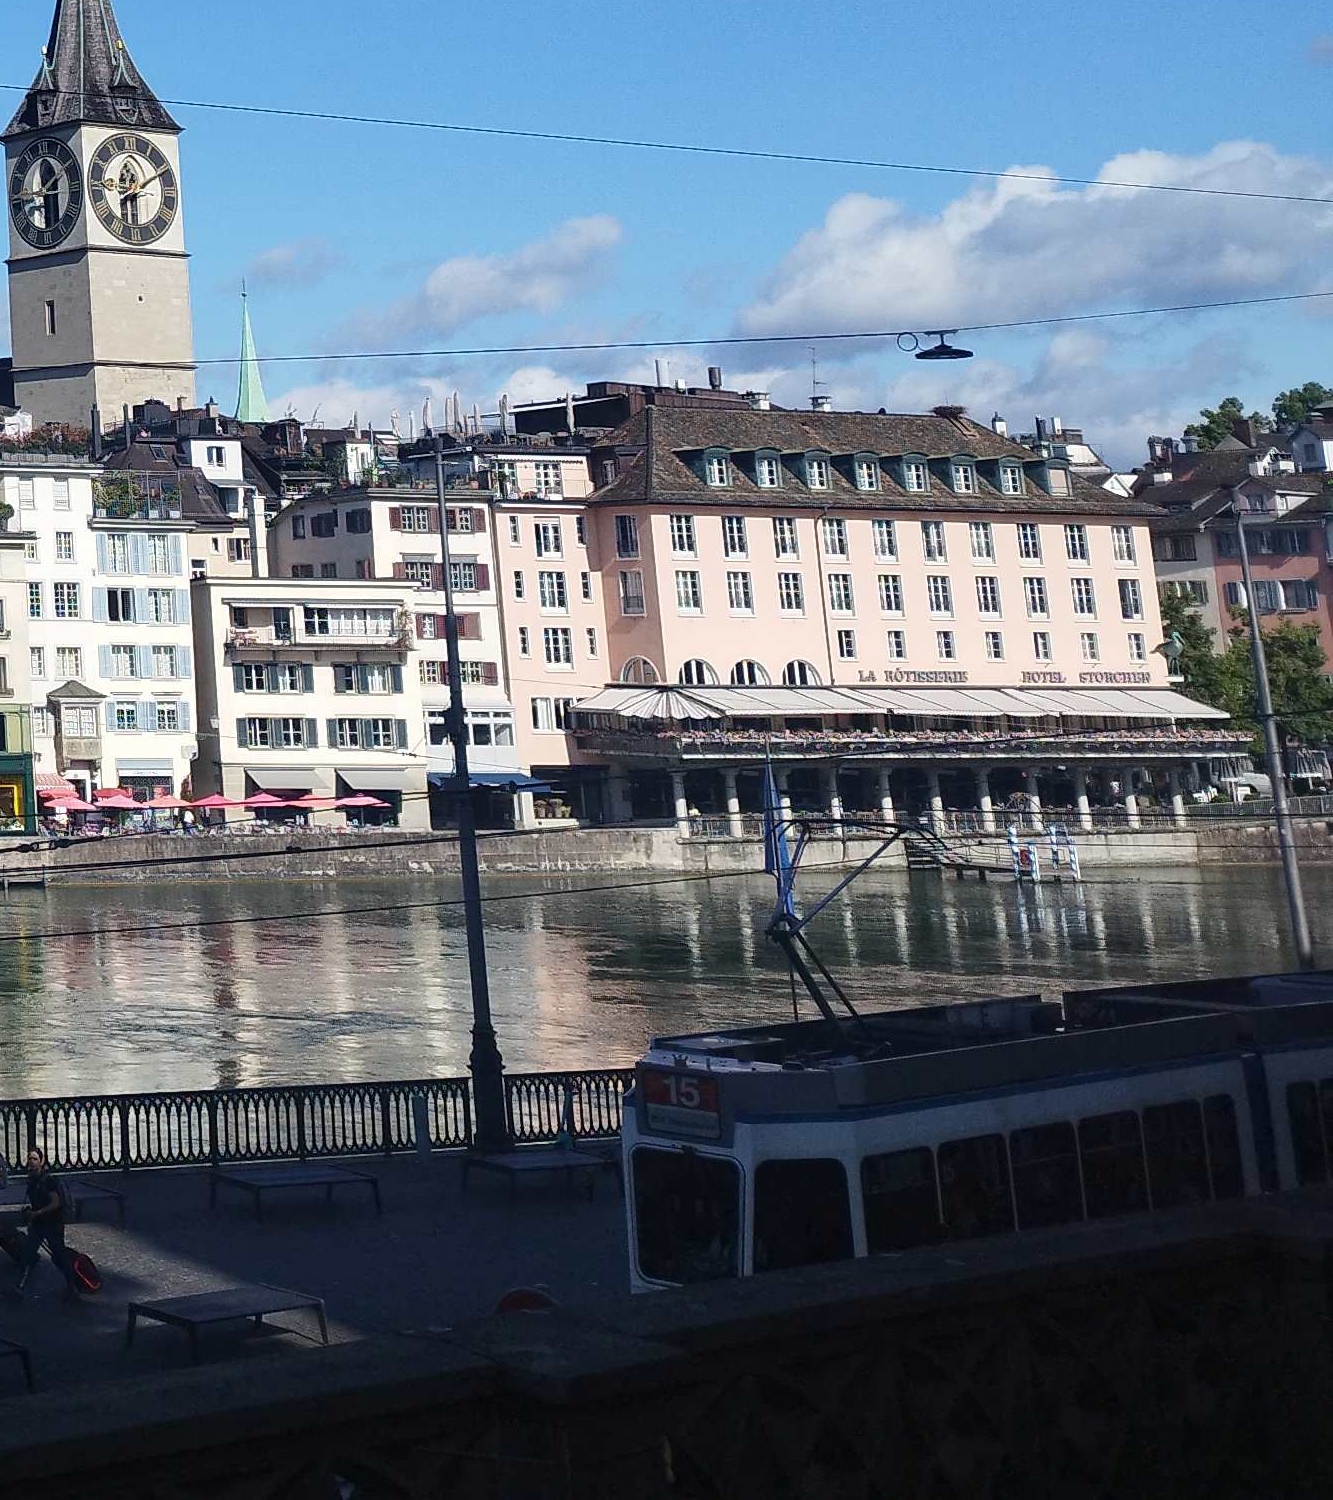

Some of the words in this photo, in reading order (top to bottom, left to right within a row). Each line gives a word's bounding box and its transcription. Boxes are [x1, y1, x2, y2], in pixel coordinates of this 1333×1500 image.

[858, 669, 877, 682] LA
[1021, 670, 1066, 684] HOTEL
[1079, 671, 1152, 685] STORCHEN
[661, 1075, 701, 1109] 15
